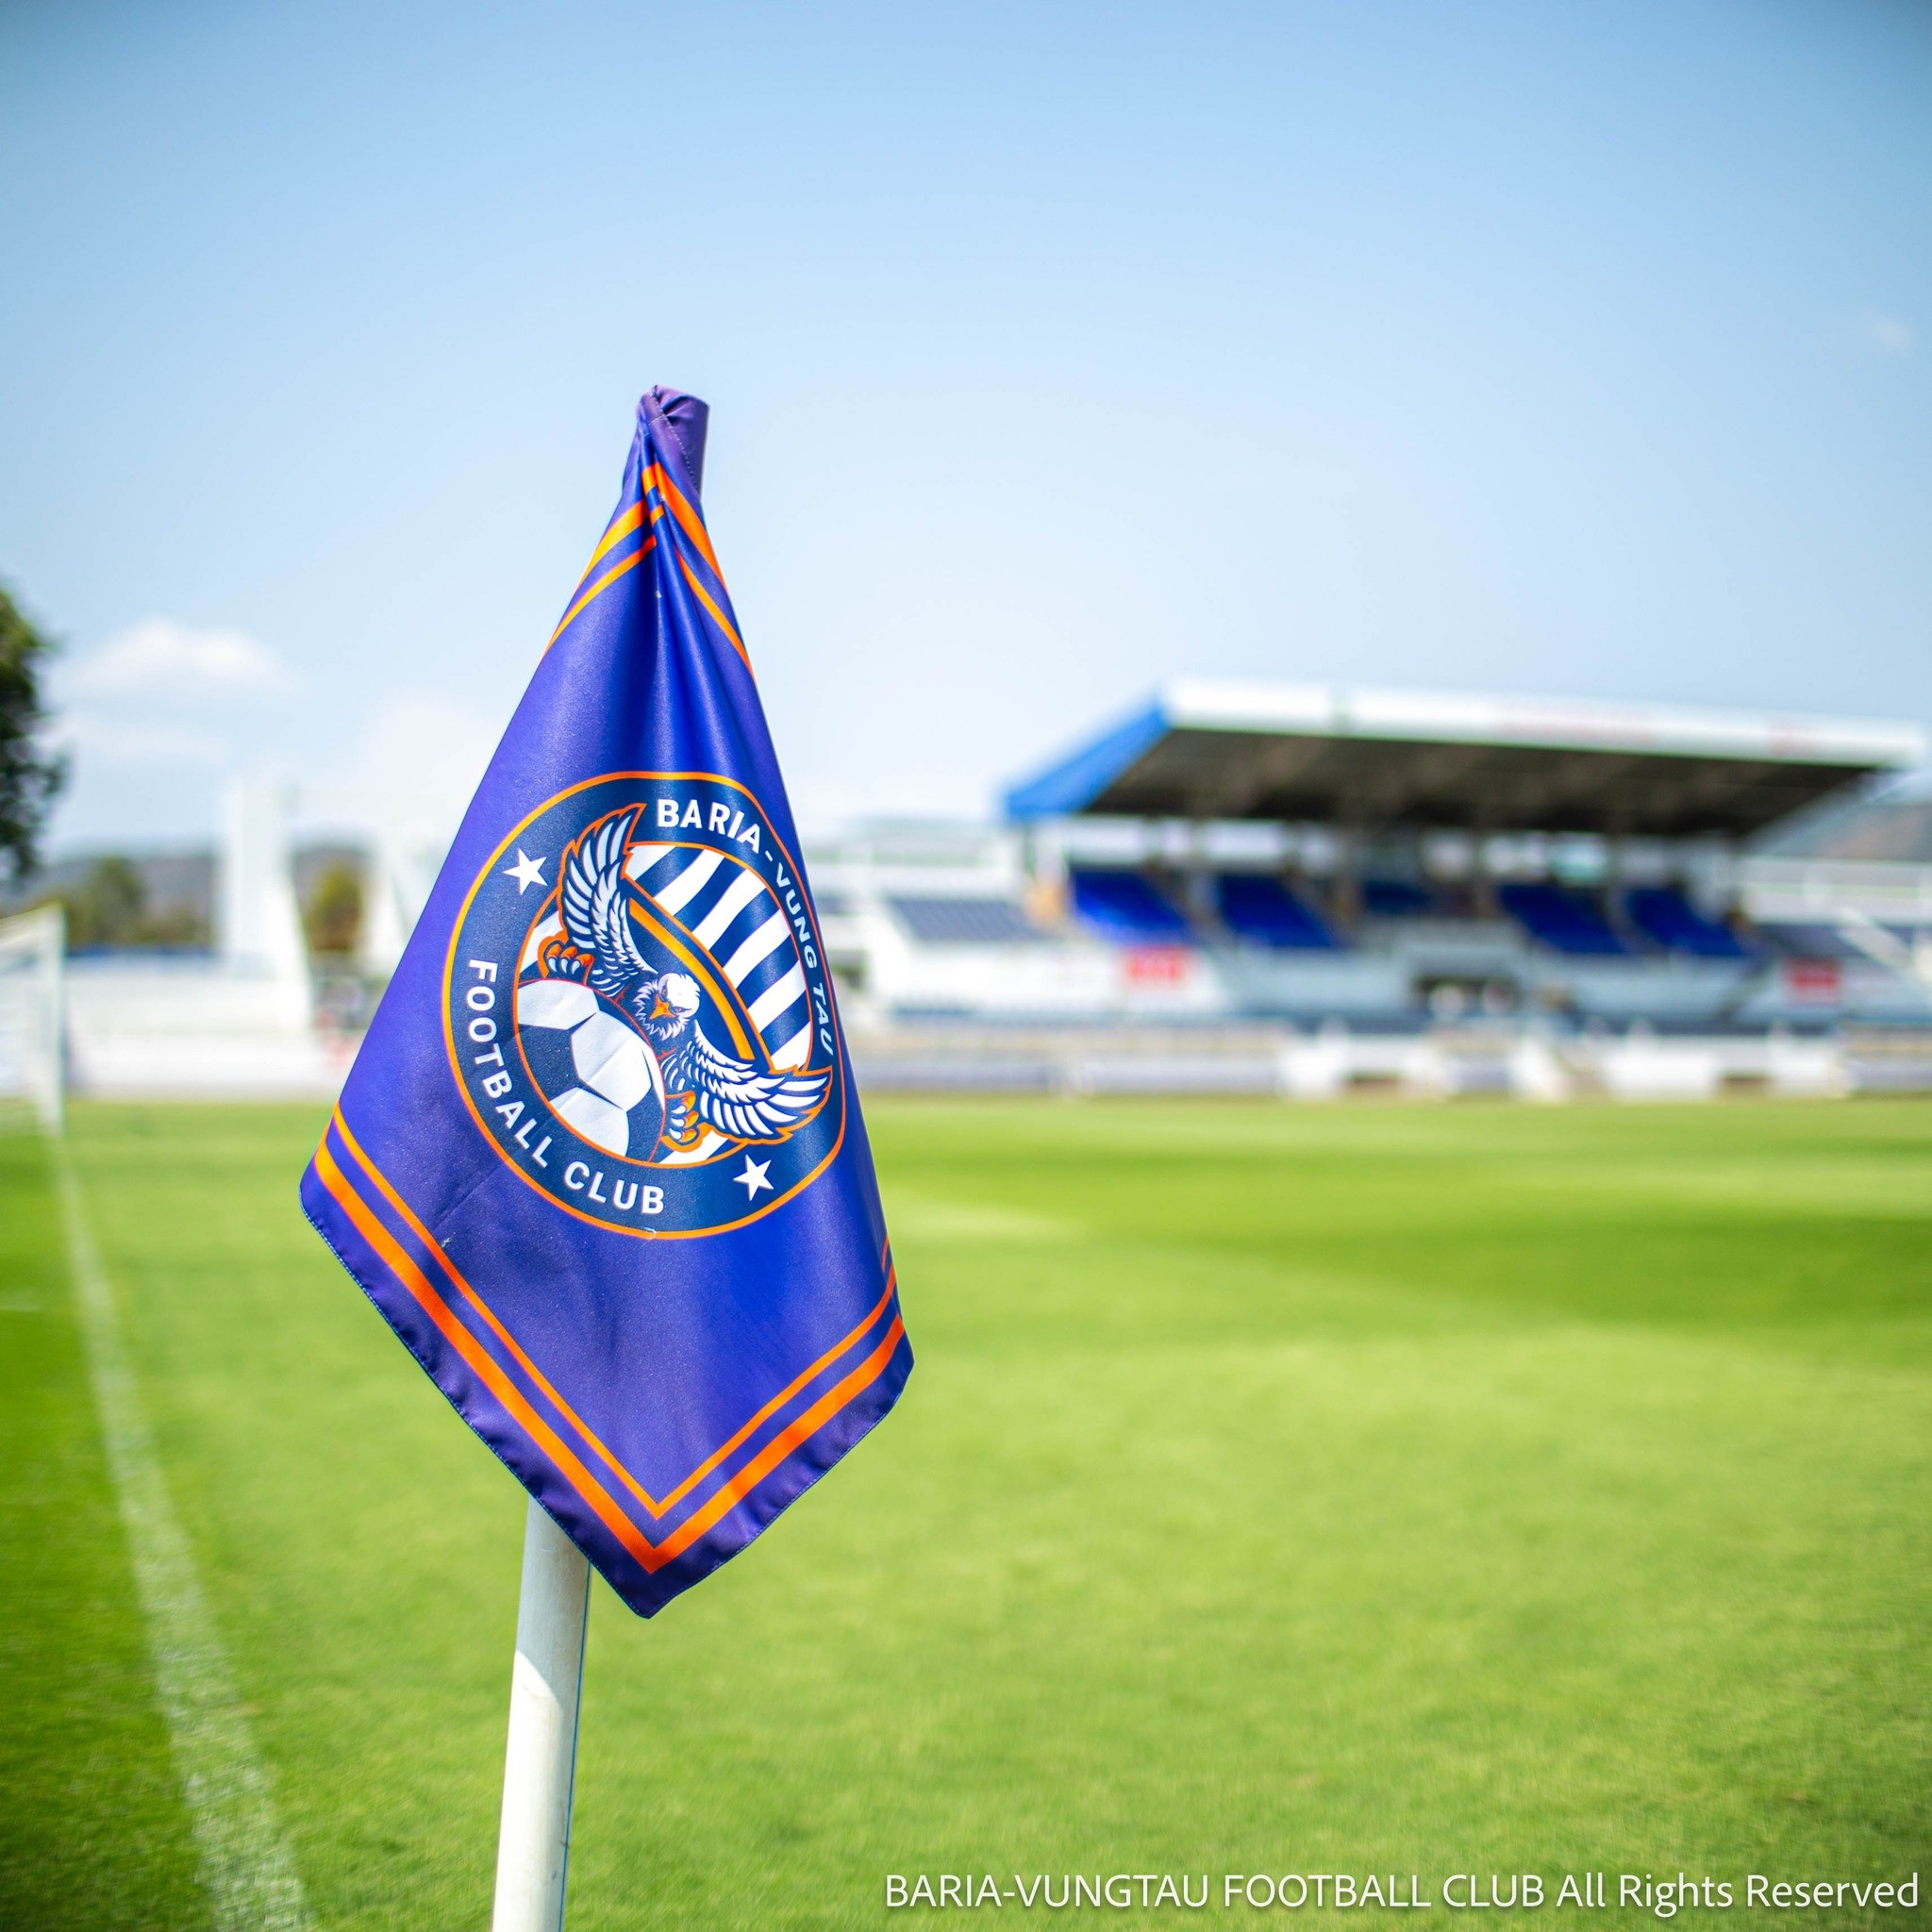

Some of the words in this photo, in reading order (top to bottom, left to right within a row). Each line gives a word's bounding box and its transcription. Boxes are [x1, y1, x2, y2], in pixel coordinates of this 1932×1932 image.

[466, 958, 553, 1168] FOOTBALL
[564, 1160, 664, 1214] CLUB
[812, 982, 834, 1056] TAU
